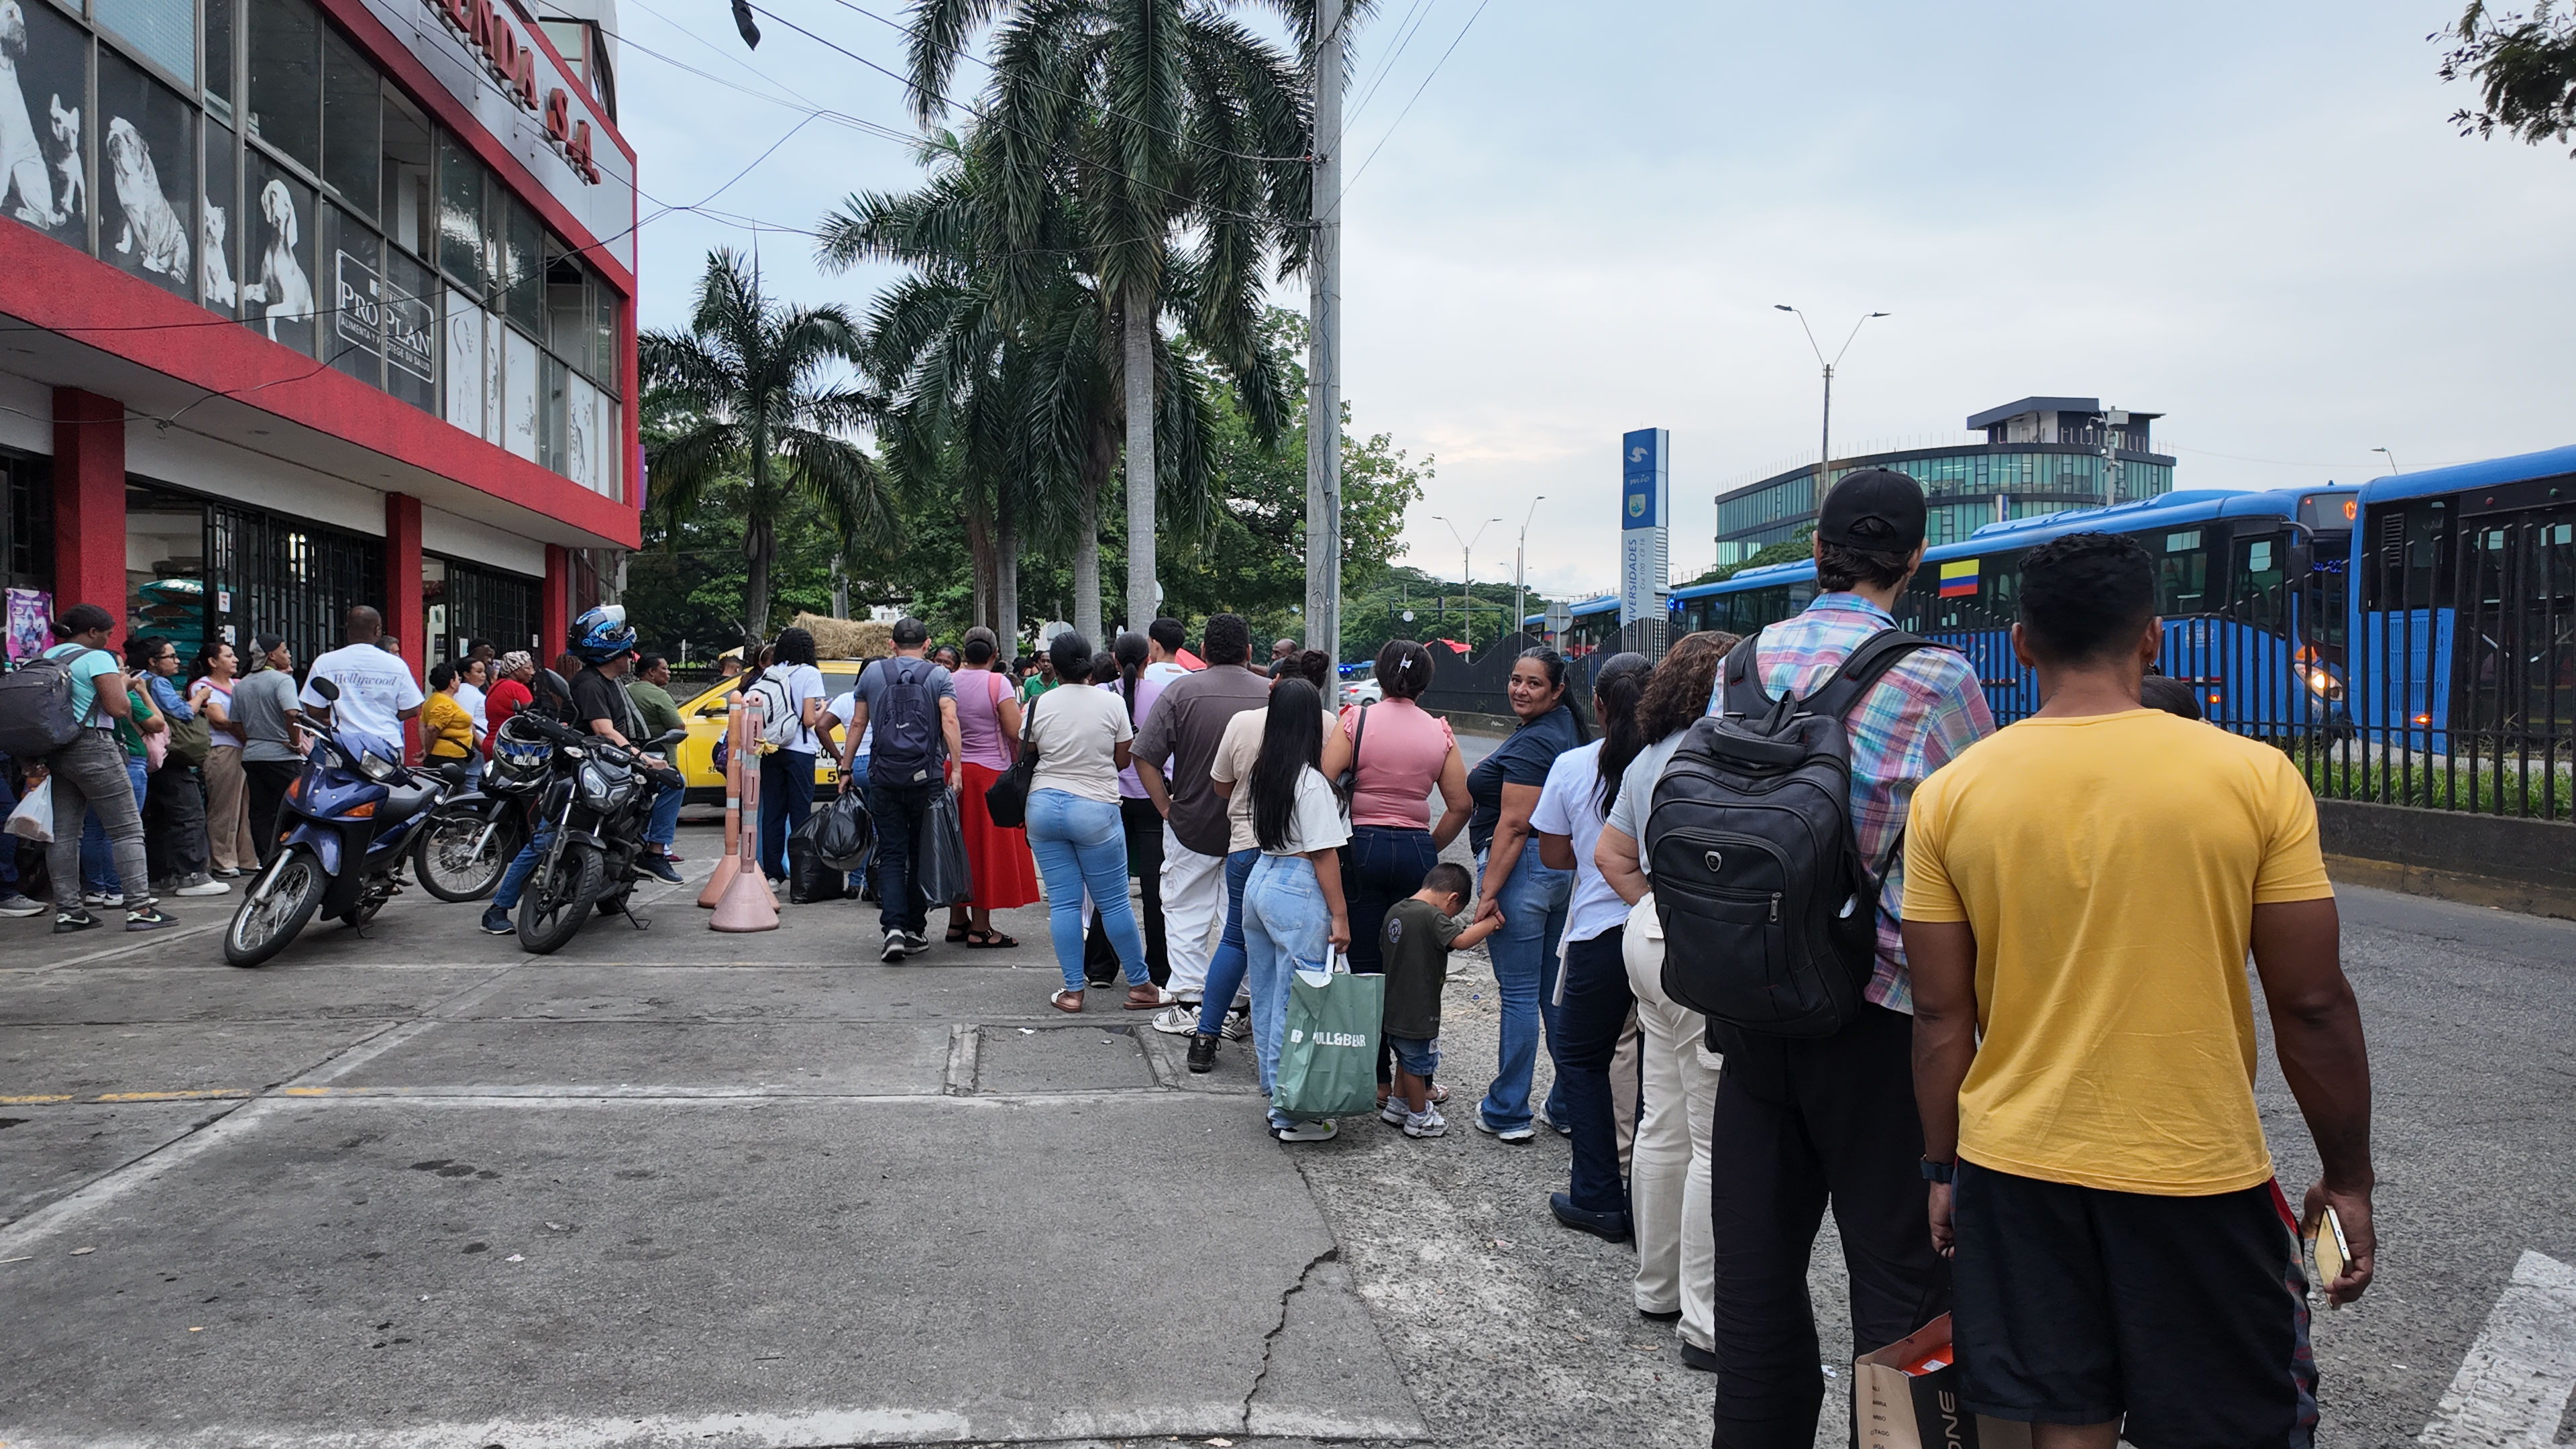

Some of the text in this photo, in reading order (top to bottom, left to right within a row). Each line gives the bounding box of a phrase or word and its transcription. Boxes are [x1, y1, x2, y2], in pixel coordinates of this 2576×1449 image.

[340, 281, 379, 327] PRO
[341, 317, 370, 340] ALIMENTA
[376, 336, 404, 358] POTEGE
[405, 351, 413, 364] SU
[1629, 474, 1650, 485] mio
[334, 673, 398, 686] Hollywood
[612, 751, 624, 759] TVS
